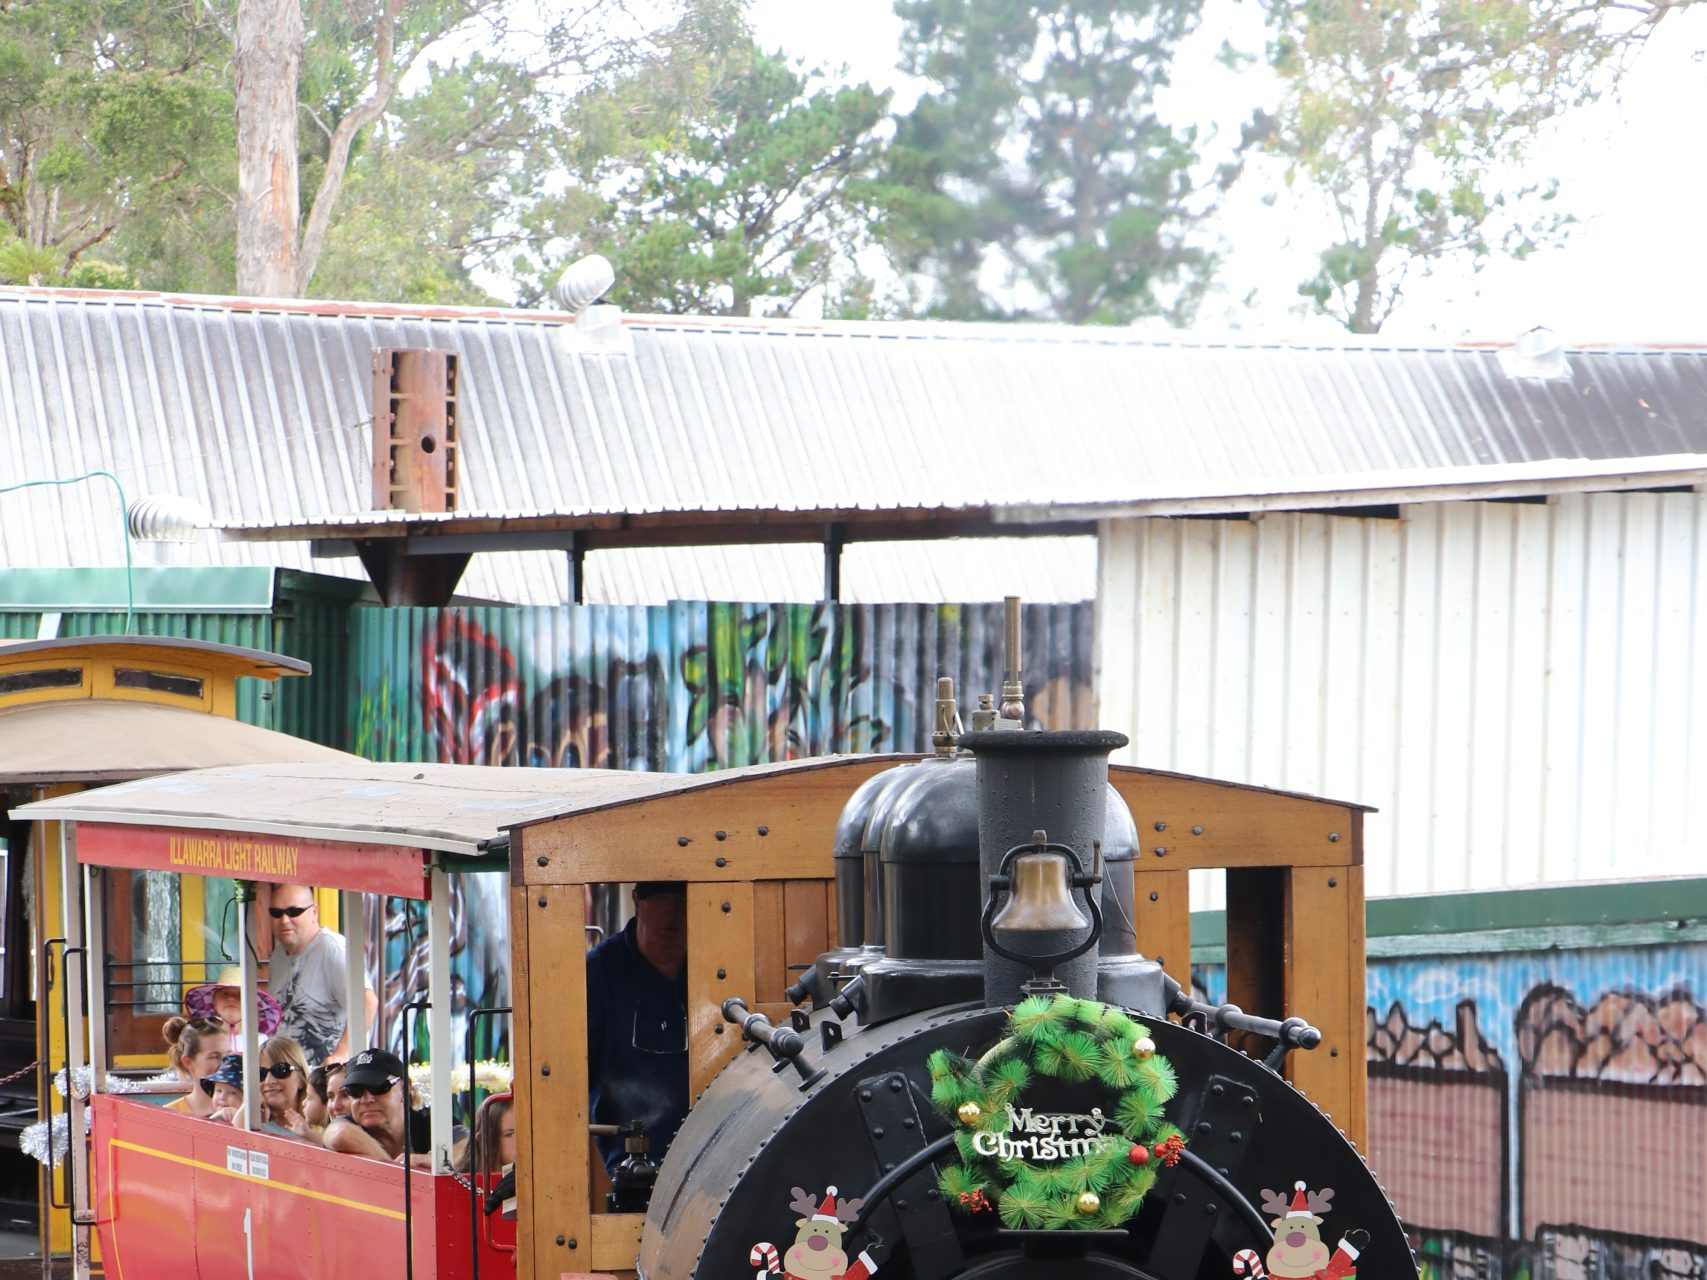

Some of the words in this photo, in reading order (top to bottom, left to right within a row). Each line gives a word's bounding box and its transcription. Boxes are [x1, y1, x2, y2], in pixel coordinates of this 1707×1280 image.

[169, 836, 223, 868] ILLAWARRA
[223, 841, 252, 872] LIGHT
[253, 844, 298, 876] RAILWAY
[1004, 1102, 1105, 1137] Merry
[972, 1130, 1116, 1162] Christm
